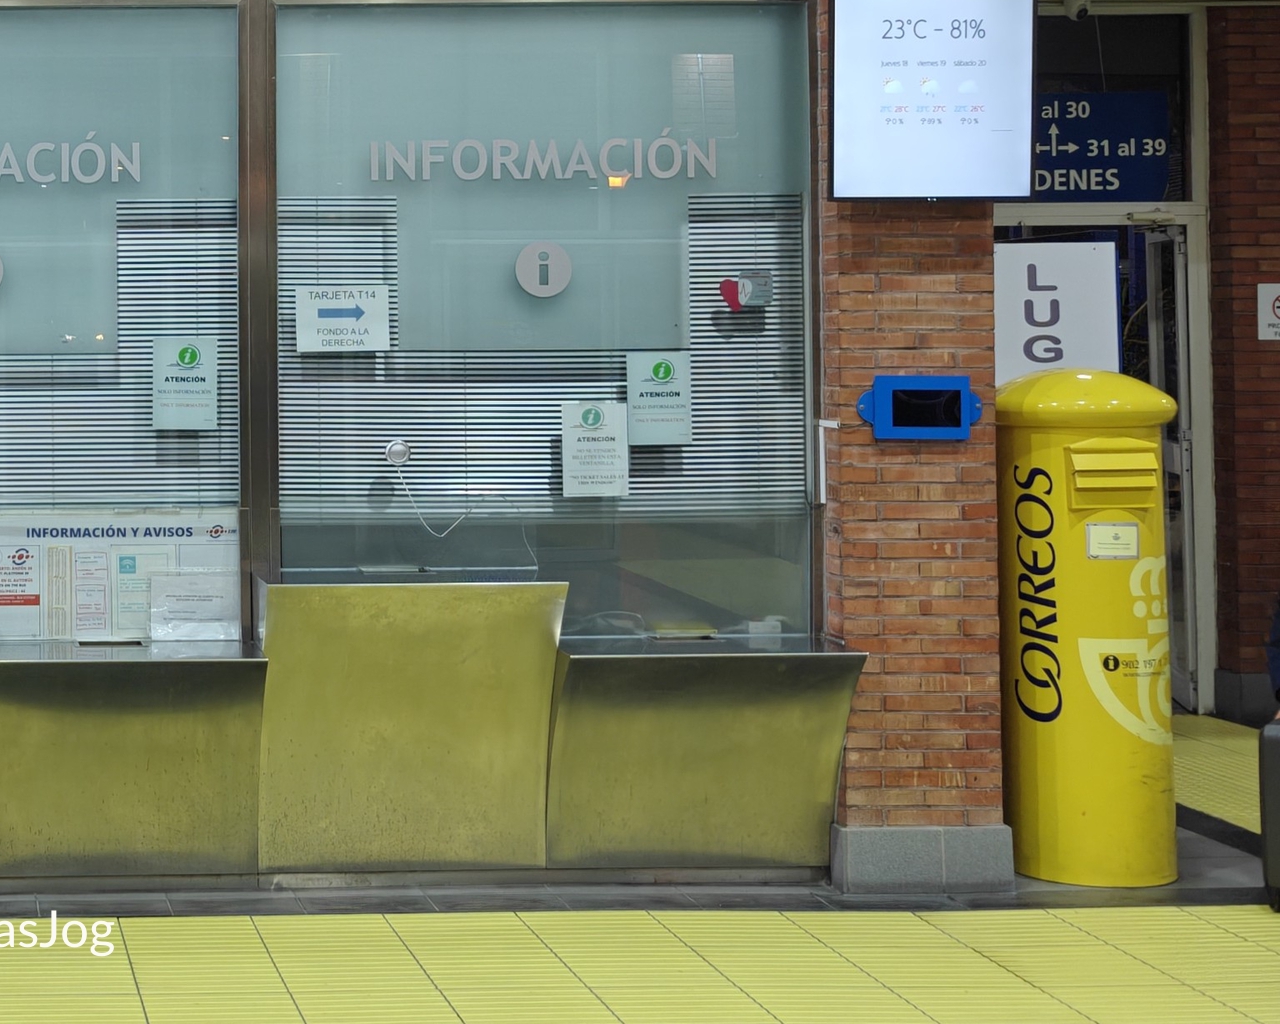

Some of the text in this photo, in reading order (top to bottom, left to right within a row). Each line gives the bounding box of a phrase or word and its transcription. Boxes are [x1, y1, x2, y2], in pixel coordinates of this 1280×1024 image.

[882, 19, 927, 39] 23°C
[950, 19, 986, 39] 81%
[1041, 100, 1090, 118] al 30
[369, 128, 718, 182] INFORMACIÓN
[1086, 138, 1167, 156] 31 al 39
[1034, 168, 1120, 191] DENES
[308, 291, 376, 300] TARJETA T14
[317, 328, 369, 336] FONDO A LA
[322, 339, 365, 347] DERECHA
[26, 525, 194, 538] INFORMACIÓN Y AVISOS
[1014, 465, 1063, 723] CORREOS
